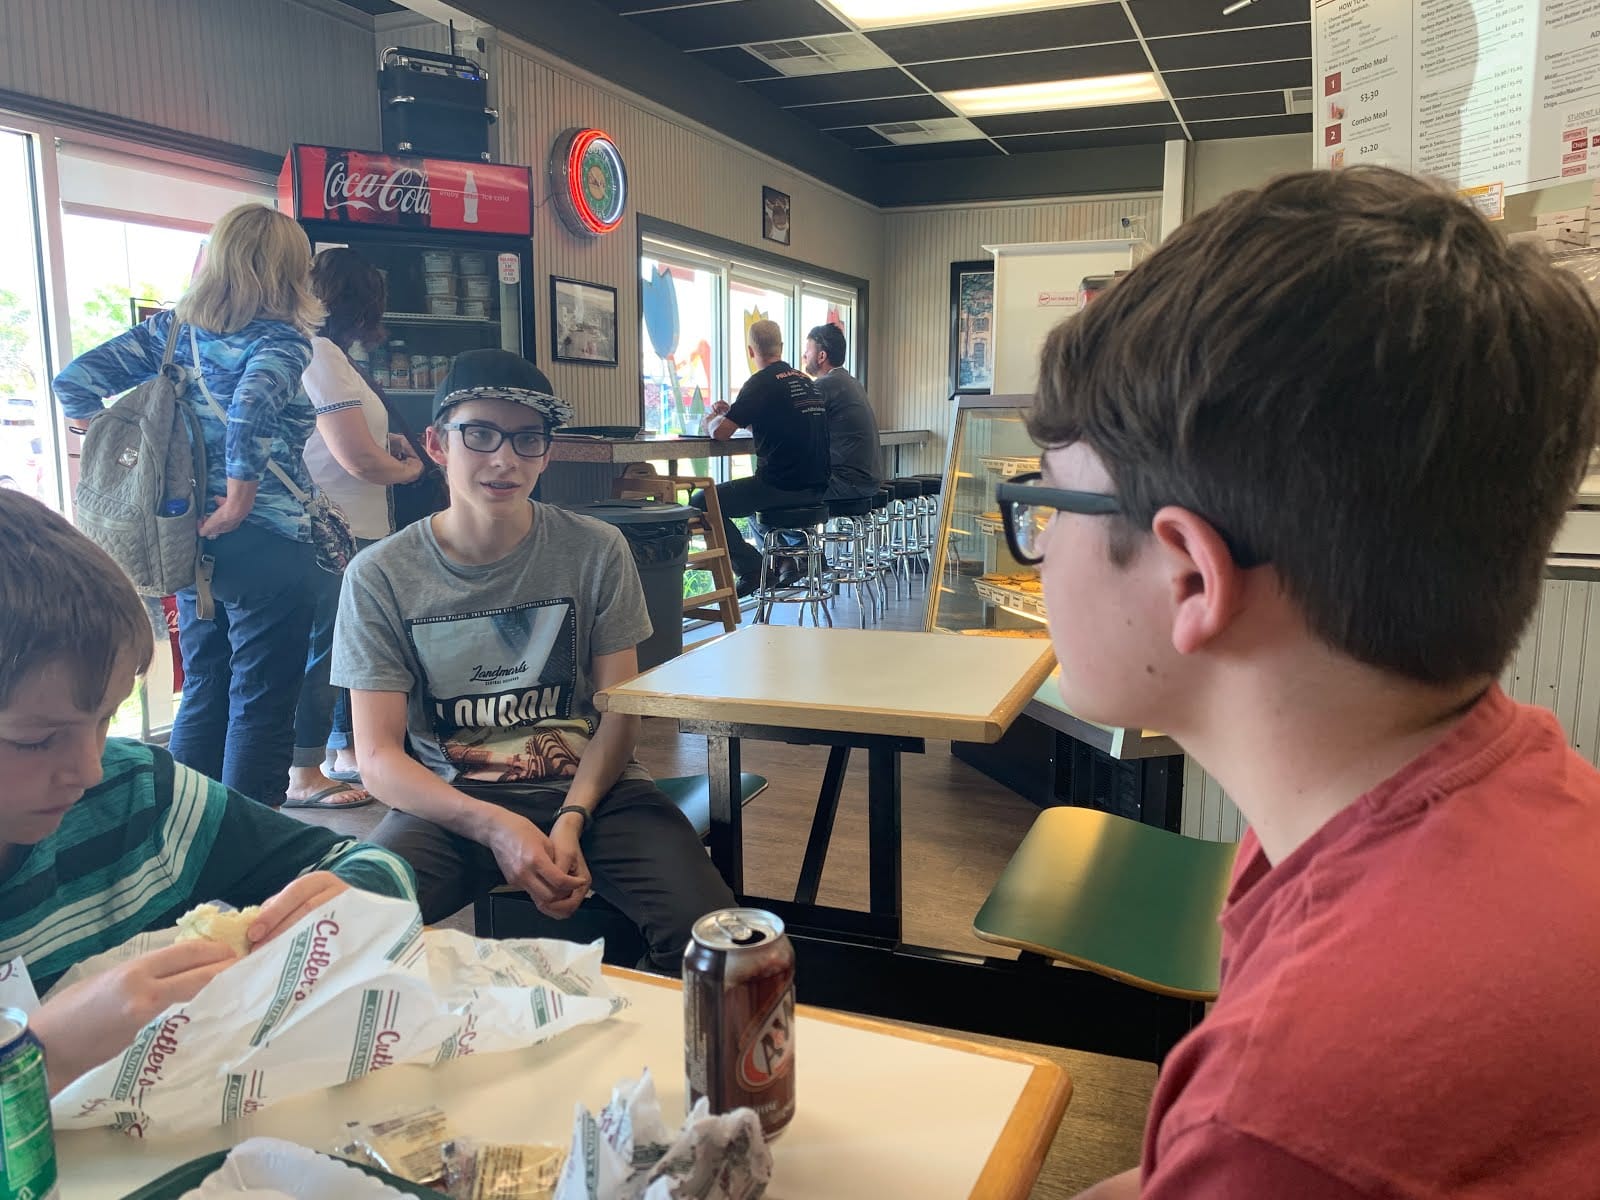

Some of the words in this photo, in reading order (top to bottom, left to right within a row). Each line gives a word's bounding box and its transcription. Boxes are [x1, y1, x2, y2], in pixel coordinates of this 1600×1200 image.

[1351, 62, 1372, 74] Combo
[1374, 55, 1388, 66] Meal
[1331, 80, 1335, 89] 1
[1360, 90, 1379, 102] $3.30
[1351, 116, 1372, 126] Combo
[1372, 109, 1388, 120] Meal
[1330, 131, 1336, 140] 2
[1360, 144, 1379, 155] $2.20
[324, 162, 431, 214] Coca-Cola
[470, 660, 529, 682] Landmarks
